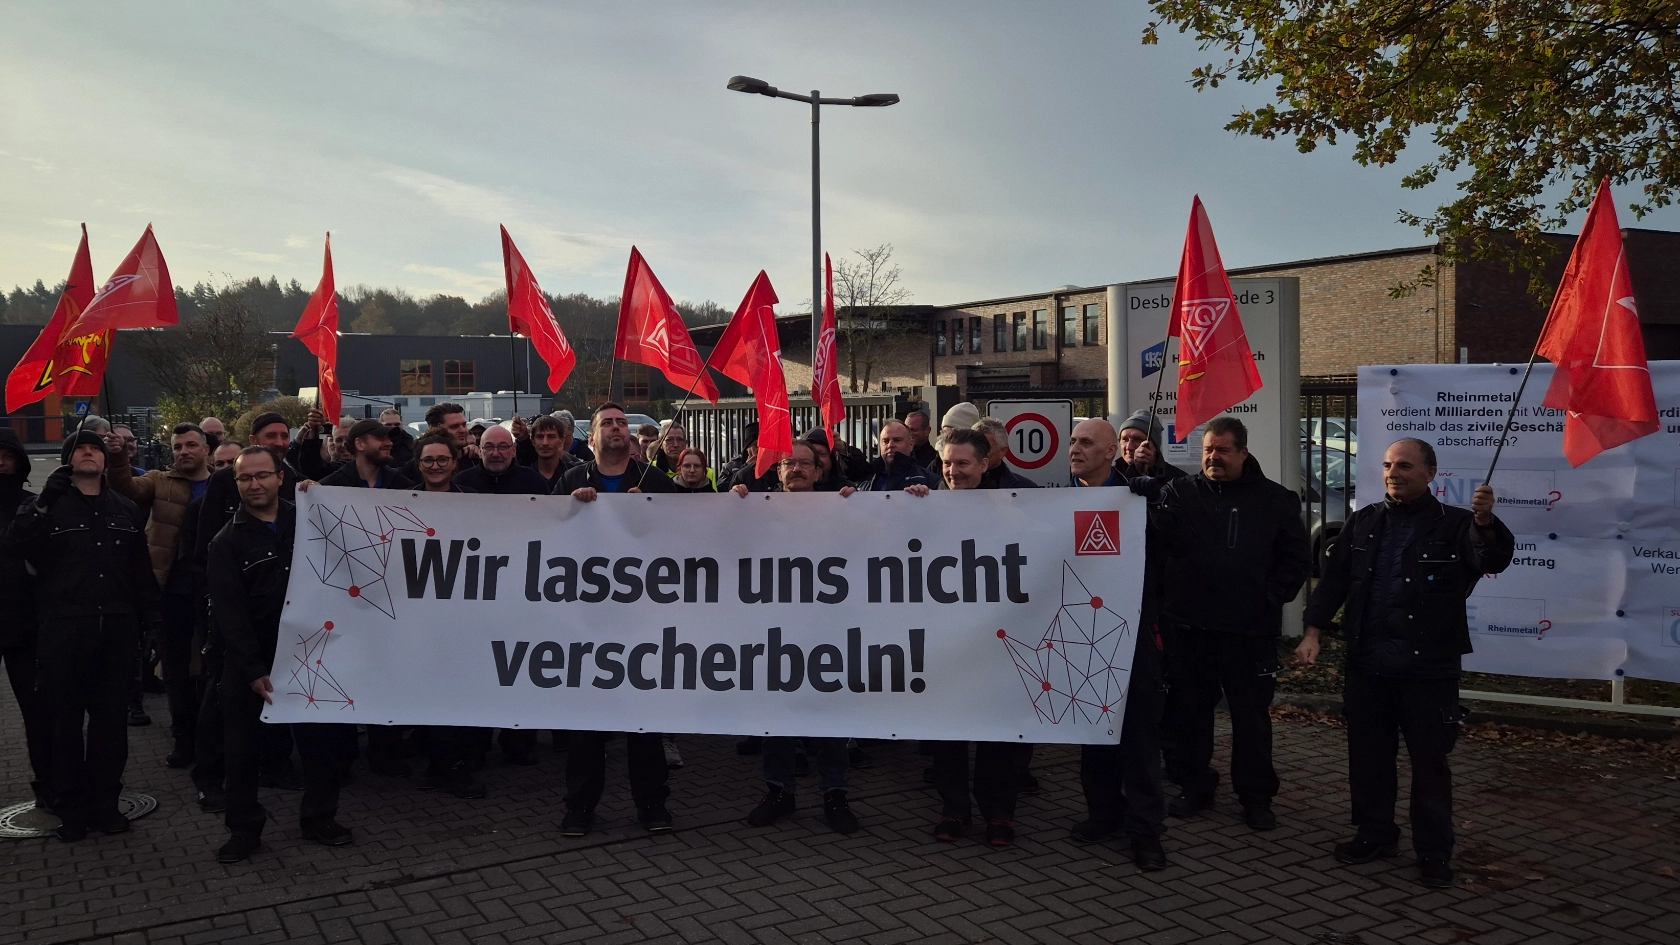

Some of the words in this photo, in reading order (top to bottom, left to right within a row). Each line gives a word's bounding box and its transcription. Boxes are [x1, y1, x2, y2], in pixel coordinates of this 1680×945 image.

[1265, 290, 1274, 304] 3
[1437, 392, 1520, 402] Rheinmetal
[1381, 407, 1431, 417] verdient
[1435, 406, 1503, 417] Milliarden
[1386, 421, 1436, 432] deshalb
[1440, 421, 1463, 432] das
[1467, 421, 1504, 432] zivile
[1508, 421, 1565, 433] Geschä
[1015, 428, 1044, 454] 10
[1437, 436, 1518, 447] abschaffen?
[1513, 542, 1536, 551] um
[1512, 556, 1555, 570] ertrag
[401, 539, 509, 600] Wir
[525, 540, 718, 603] lassen
[739, 557, 848, 604] uns
[868, 539, 1029, 603] nicht
[491, 627, 925, 693] verscherbeln!
